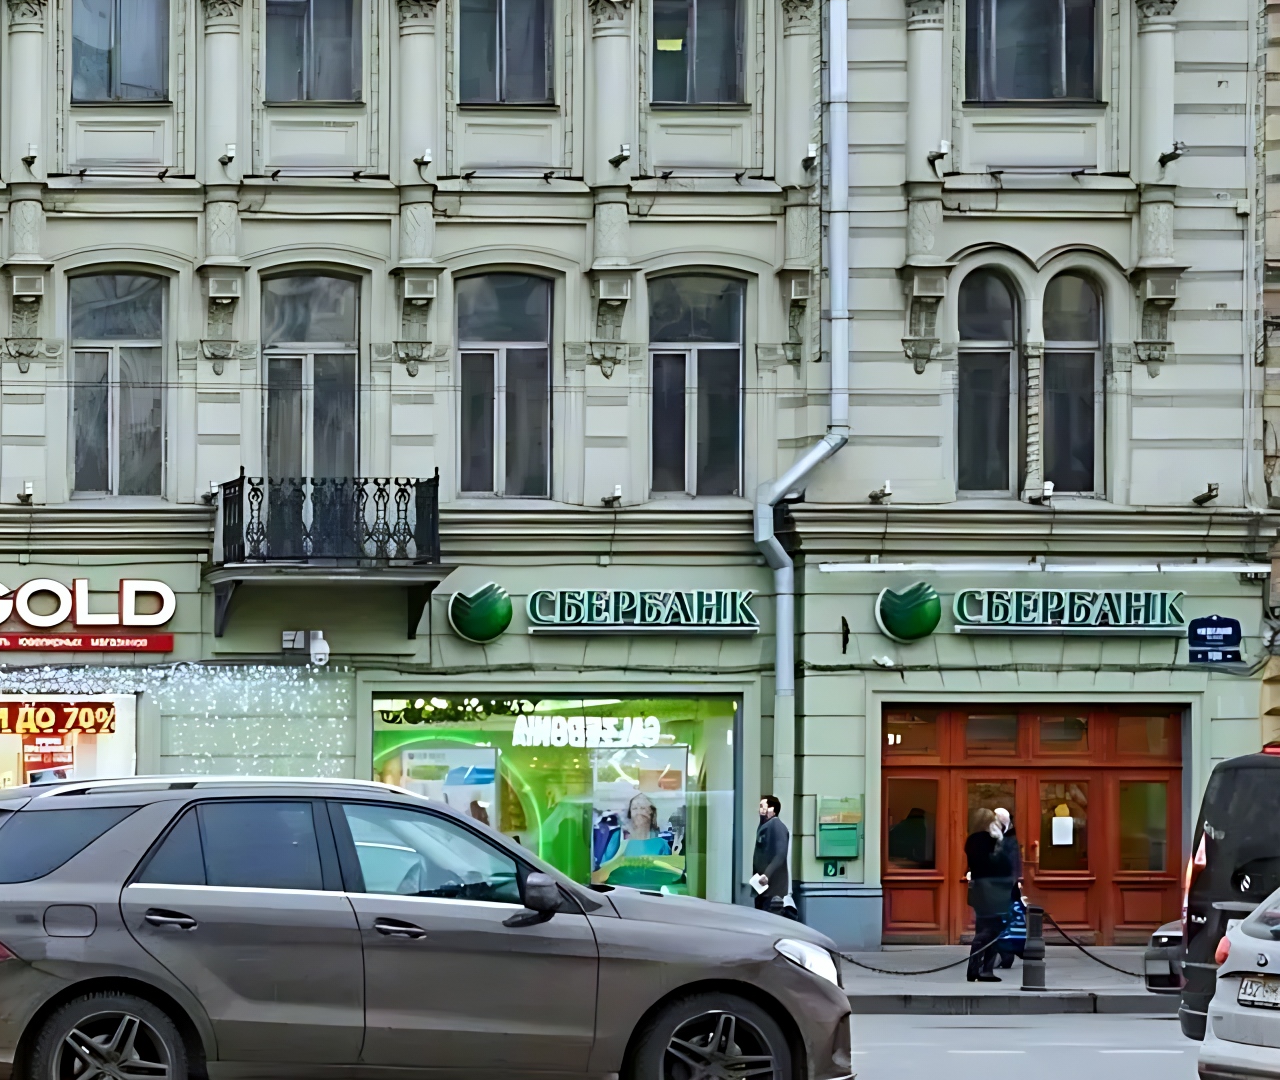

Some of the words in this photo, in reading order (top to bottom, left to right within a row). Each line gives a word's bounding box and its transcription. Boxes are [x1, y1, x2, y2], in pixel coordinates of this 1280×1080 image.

[526, 589, 761, 625] СБЕРБАНК
[952, 588, 1188, 625] СБЕРБАНК
[16, 705, 56, 732] ДО
[63, 707, 116, 730] 70%
